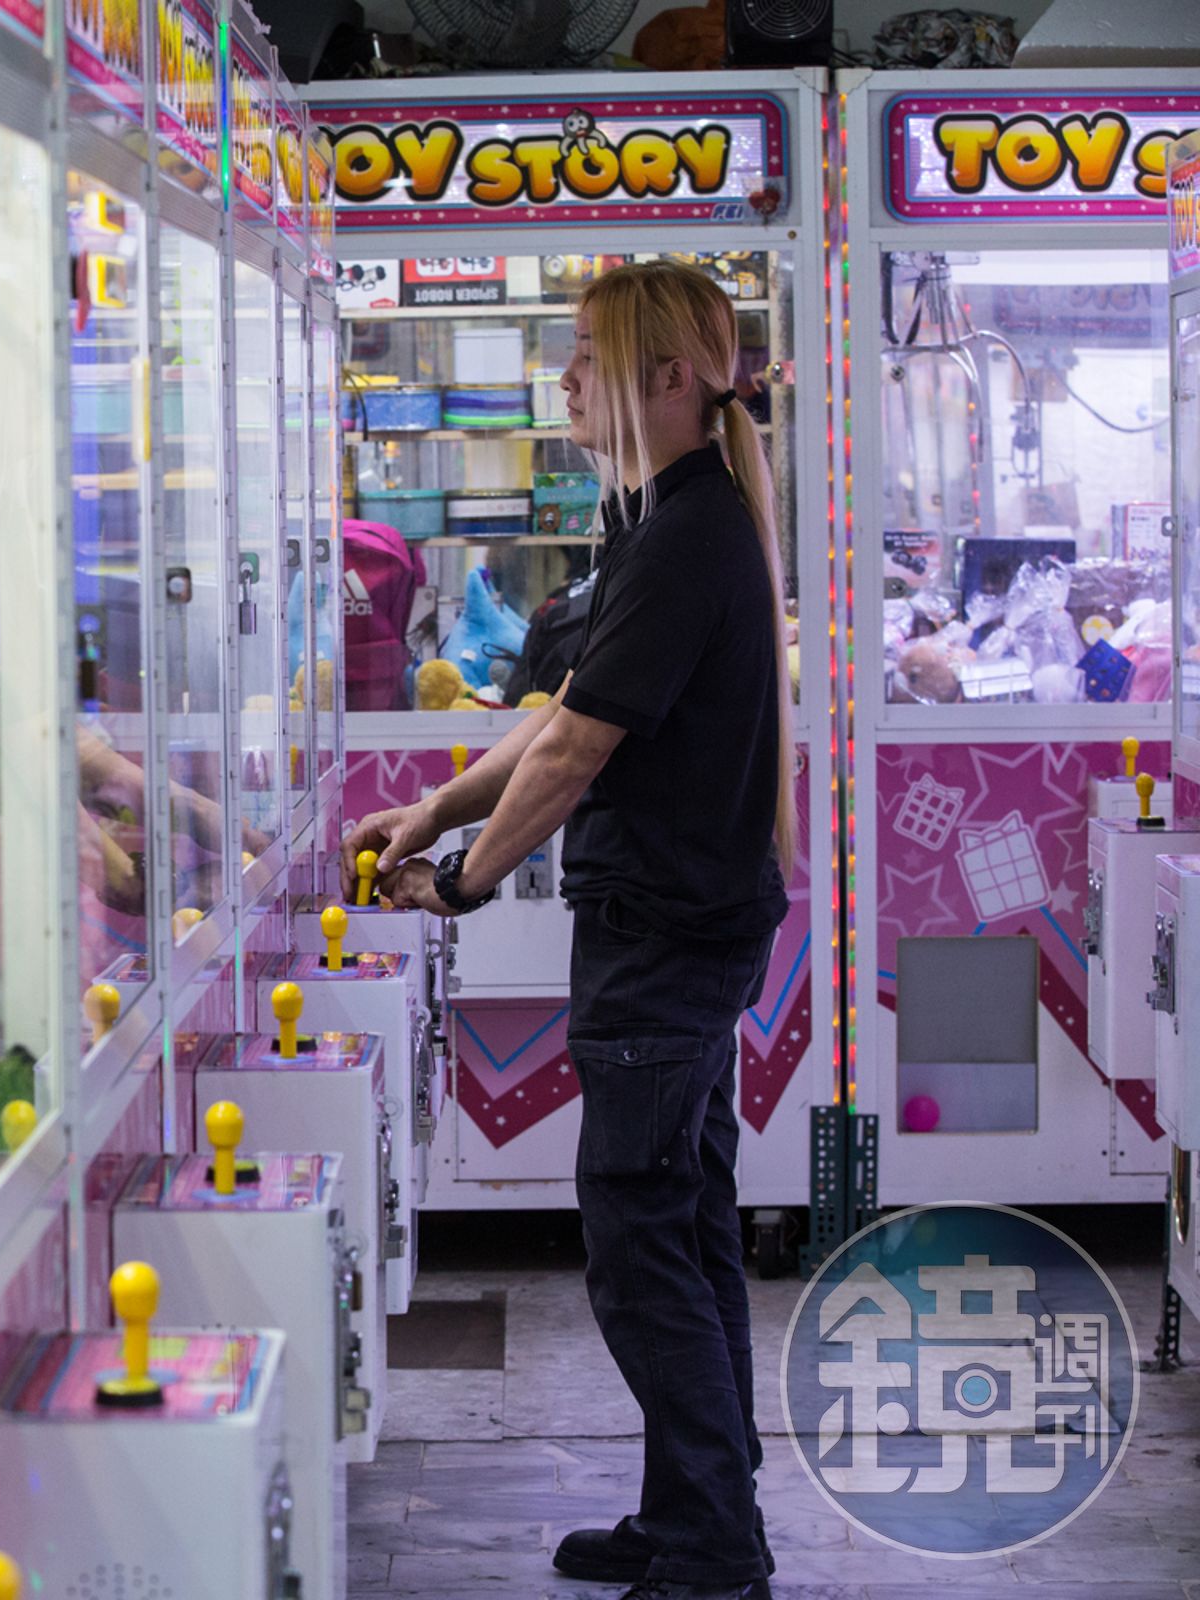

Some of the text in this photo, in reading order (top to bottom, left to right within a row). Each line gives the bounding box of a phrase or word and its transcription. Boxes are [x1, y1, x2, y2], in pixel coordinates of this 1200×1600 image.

[322, 118, 464, 202] OY
[466, 125, 732, 206] STORY
[933, 110, 1131, 194] TOY
[414, 288, 454, 303] ROBOT
